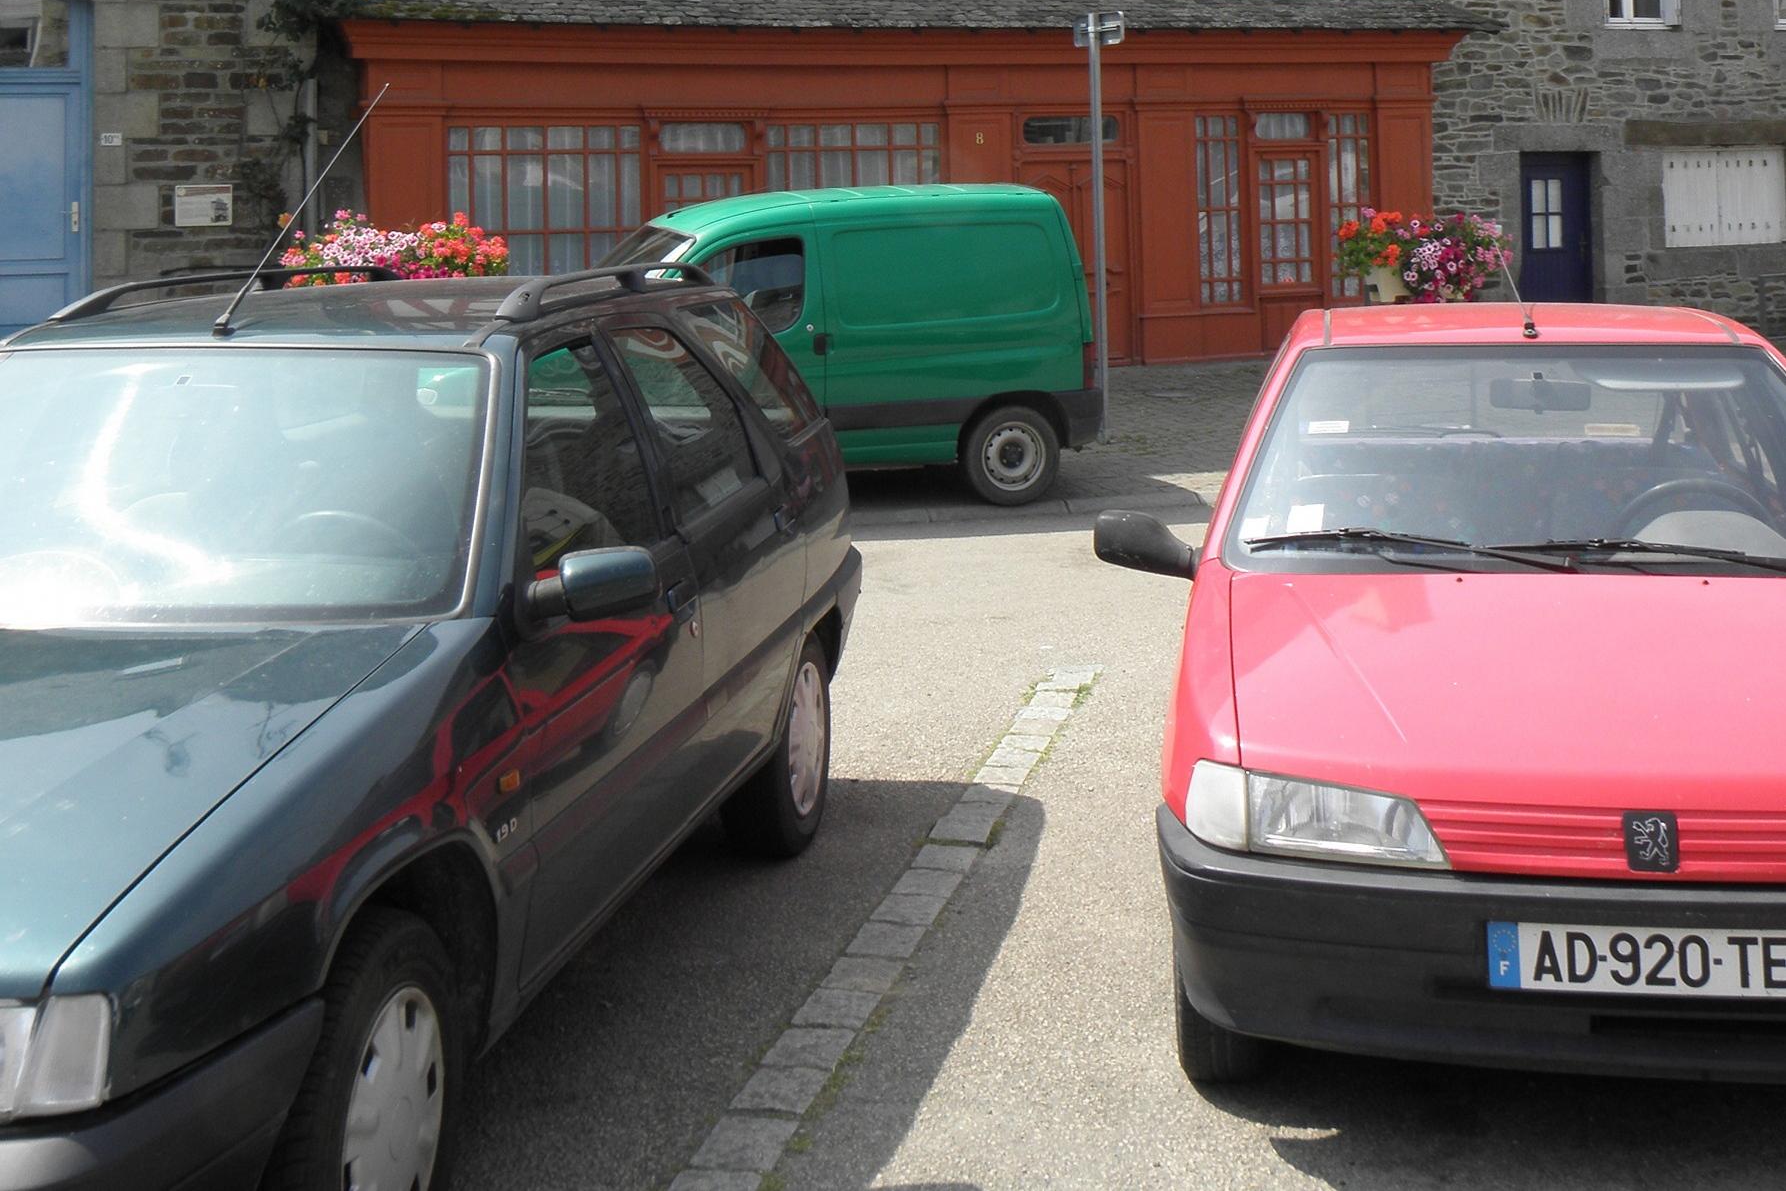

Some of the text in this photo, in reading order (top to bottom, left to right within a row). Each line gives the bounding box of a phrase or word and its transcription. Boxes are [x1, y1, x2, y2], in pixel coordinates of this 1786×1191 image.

[976, 131, 984, 145] 8
[1533, 930, 1786, 989] AD-920-TE
[1500, 961, 1510, 976] F
